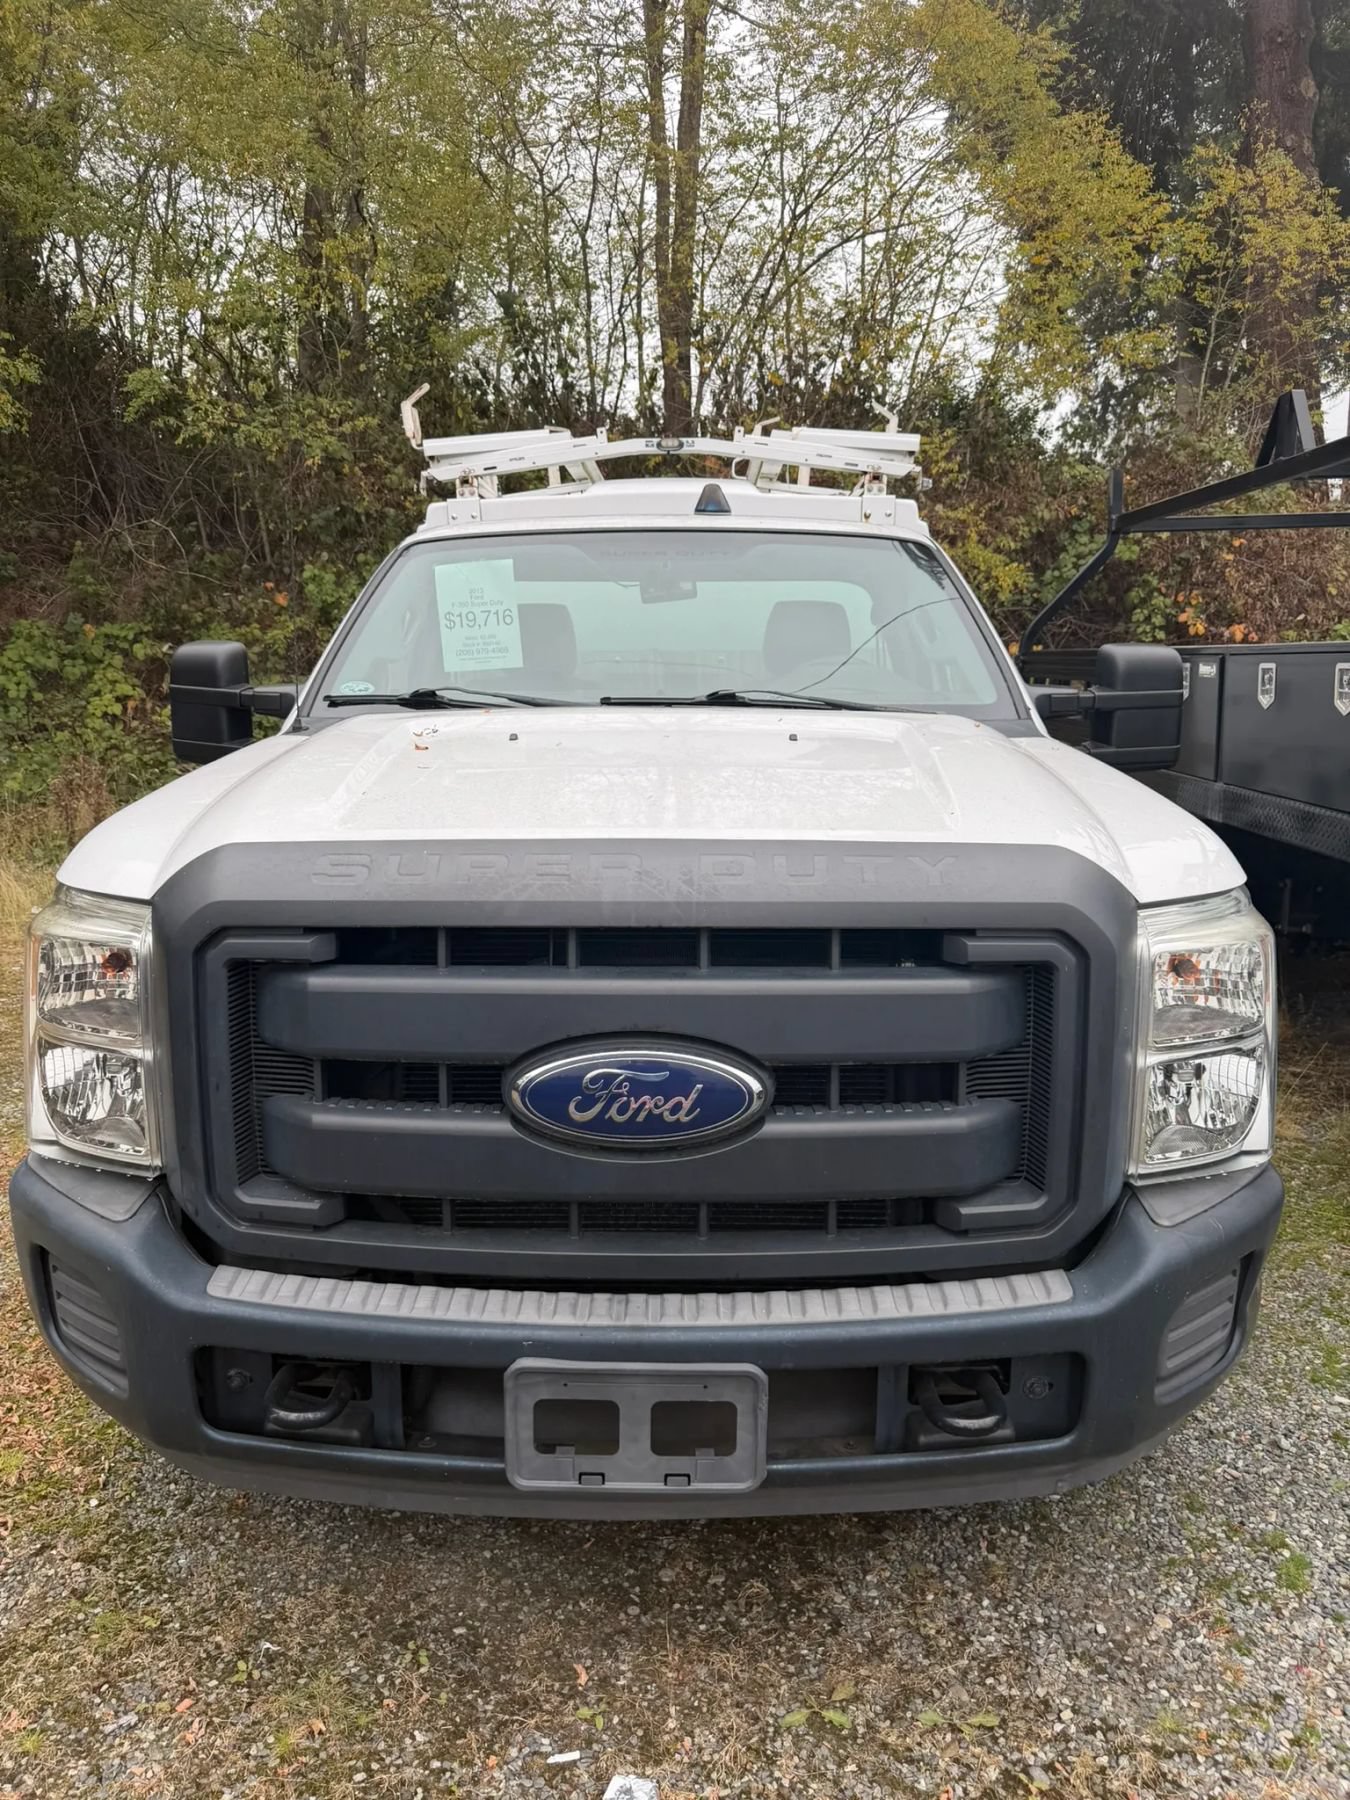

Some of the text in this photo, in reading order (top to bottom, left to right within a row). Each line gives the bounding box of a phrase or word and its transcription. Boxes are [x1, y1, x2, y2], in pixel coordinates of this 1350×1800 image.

[444, 608, 514, 631] $19,716
[310, 851, 960, 886] SUPER DUTY
[568, 1067, 704, 1124] Ford
